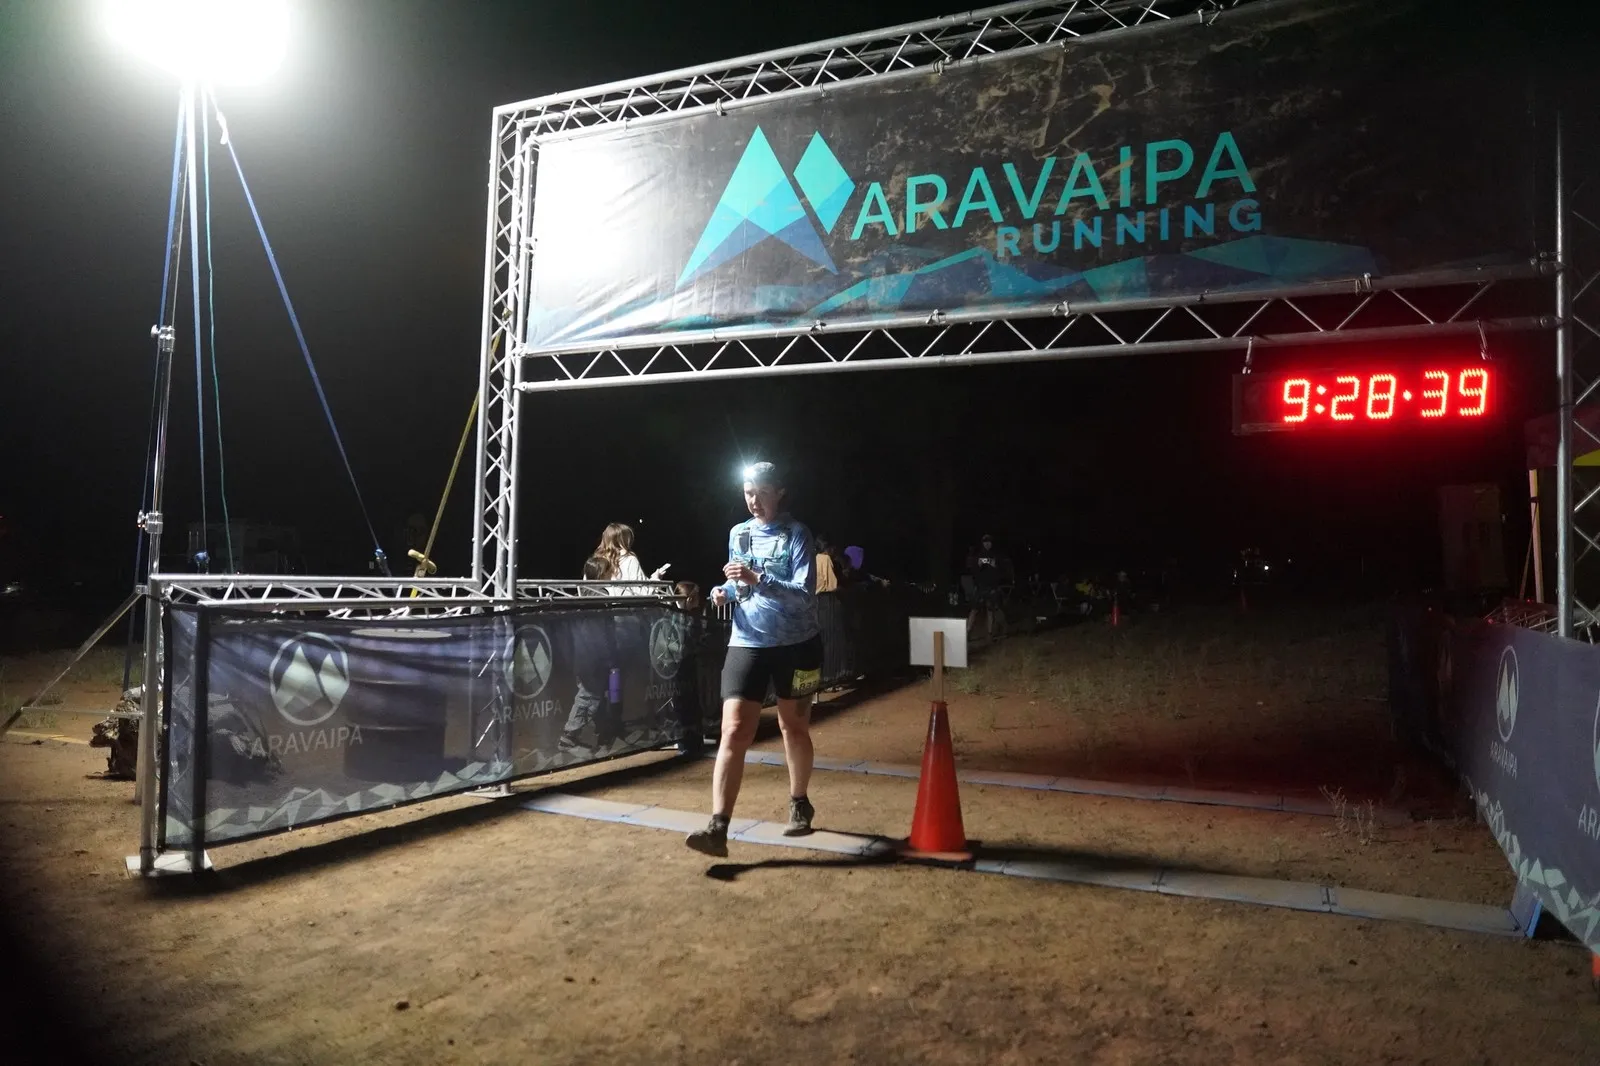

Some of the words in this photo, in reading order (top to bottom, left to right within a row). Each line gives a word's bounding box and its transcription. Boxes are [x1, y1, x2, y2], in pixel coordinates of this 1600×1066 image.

[851, 131, 1257, 240] ARAVAIPA
[997, 198, 1262, 258] RUNNING
[491, 699, 563, 724] ARAVAIPA
[249, 724, 363, 759] ARAVAIPA
